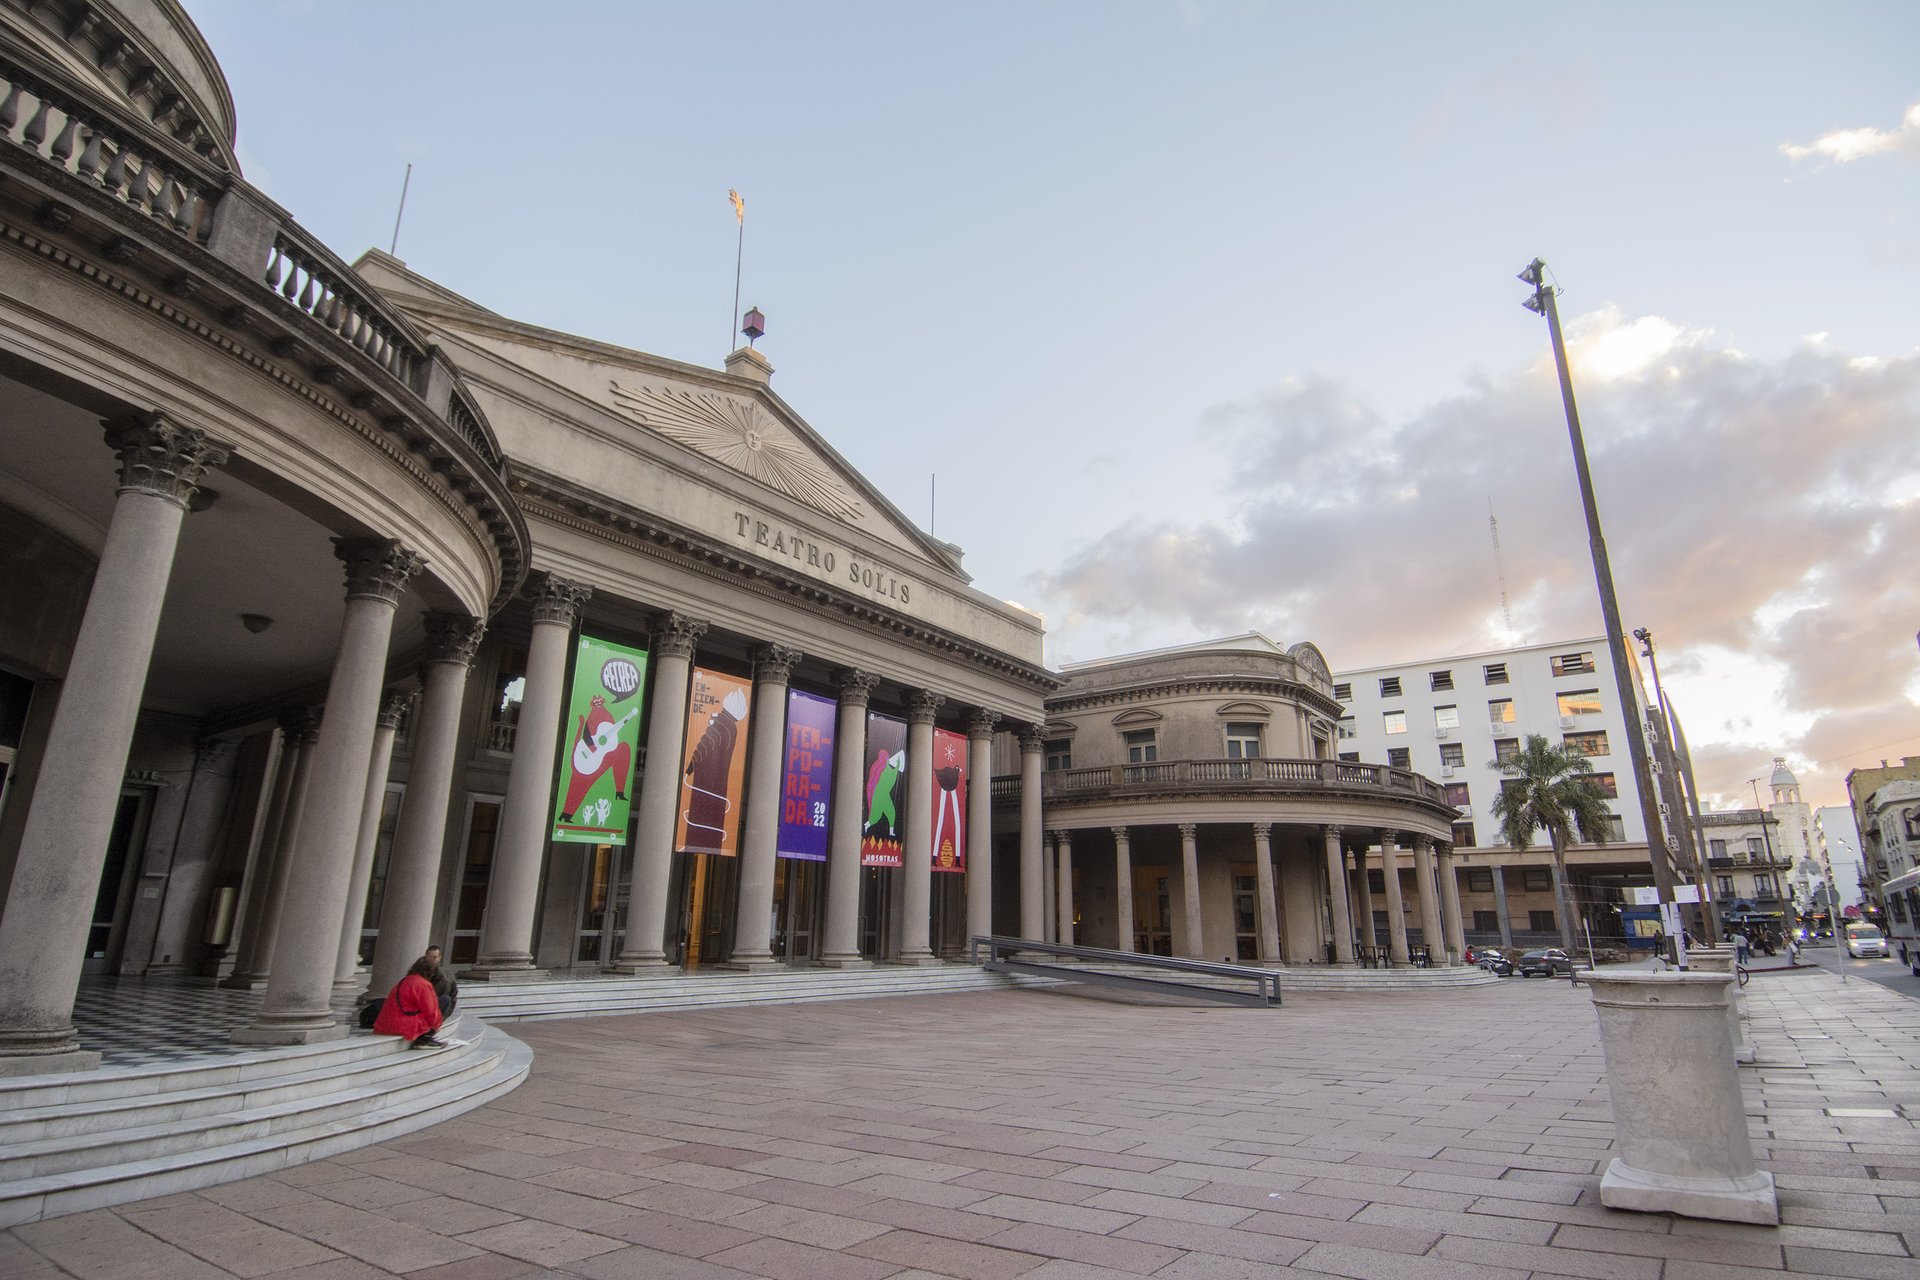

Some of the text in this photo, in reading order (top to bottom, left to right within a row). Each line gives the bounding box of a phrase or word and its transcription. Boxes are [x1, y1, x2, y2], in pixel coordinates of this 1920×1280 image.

[735, 511, 911, 604] TEATRO SOLIS
[603, 661, 639, 693] RECREA
[790, 723, 832, 750] TEM-
[788, 747, 824, 773] PO-
[786, 773, 820, 799] RA-
[813, 801, 826, 815] 20
[813, 813, 825, 827] 22
[865, 854, 898, 863] NOSOTRAS
